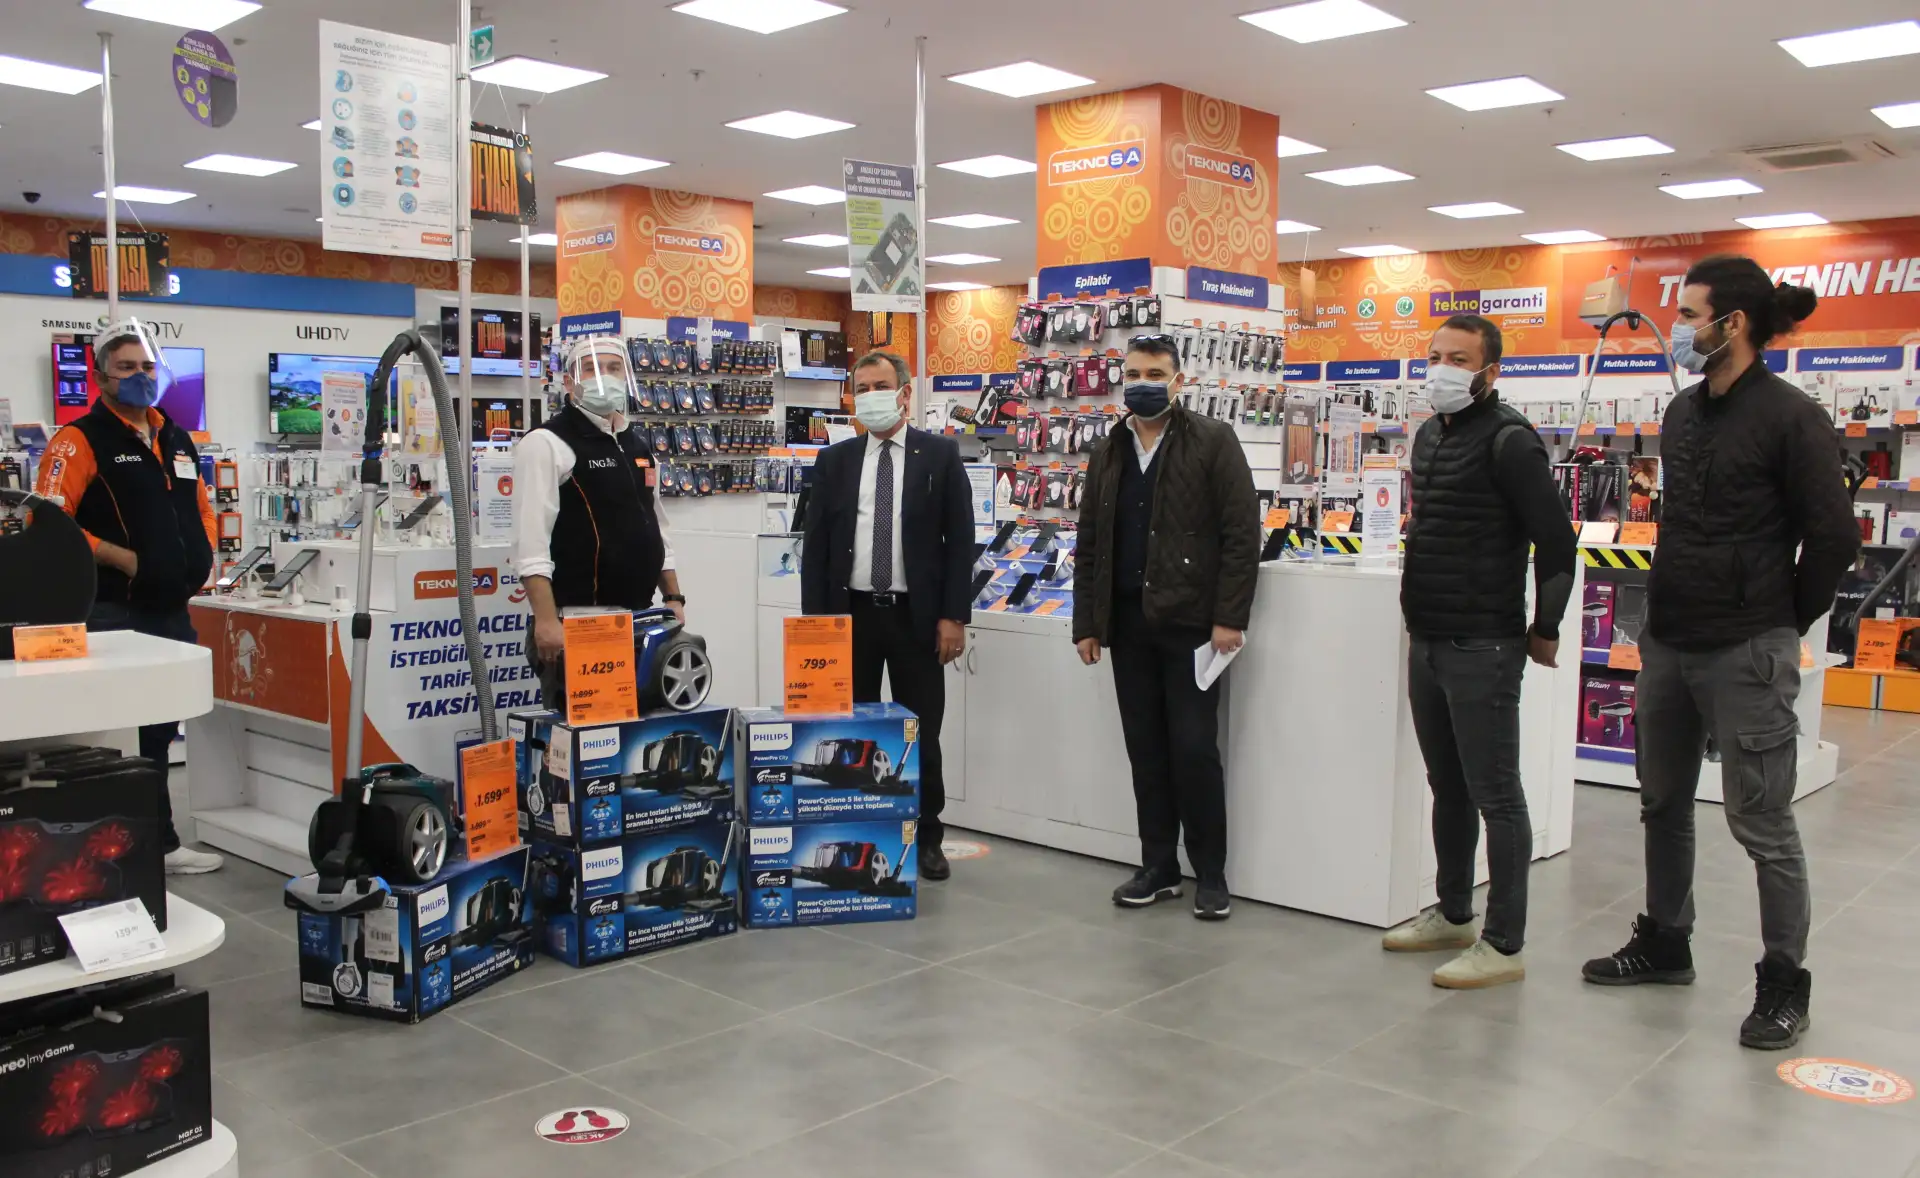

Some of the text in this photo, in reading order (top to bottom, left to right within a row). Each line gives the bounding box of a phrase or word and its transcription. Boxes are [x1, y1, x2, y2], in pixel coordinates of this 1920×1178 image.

[1052, 150, 1141, 175] TEKNOSA
[1186, 153, 1253, 182] TEKNOSA
[565, 232, 613, 249] TEKNOSA
[656, 233, 723, 251] TEKNOSA
[1075, 274, 1112, 288] Epilatör
[1202, 280, 1254, 298] Tıraş Makineleri
[42, 319, 92, 330] SAMSUNG
[1503, 316, 1544, 326] TEKNOSA
[566, 321, 581, 333] Kablo
[712, 328, 733, 338] ablolar
[1603, 358, 1657, 368] Mutfak Robotu
[1812, 354, 1887, 365] Kahve Makineleri
[1537, 362, 1575, 371] Makineleri
[114, 453, 142, 463] axess
[588, 459, 606, 469] ING
[417, 573, 493, 590] TEKNSA
[1586, 681, 1611, 690] arzum
[753, 733, 789, 742] PHILIPS
[583, 738, 617, 750] PHILIPS
[779, 772, 786, 781] 5
[608, 782, 615, 792] 8
[797, 797, 846, 806] PowerCyclone
[0, 806, 14, 816] me
[625, 813, 635, 821] En
[649, 807, 670, 817] tozları
[670, 805, 682, 813] bile
[797, 804, 822, 813] yüksek
[823, 803, 852, 813] düzeyde
[625, 818, 654, 829] oranında
[654, 814, 674, 824] toplar
[753, 836, 789, 846] PHILIPS
[585, 857, 620, 870] PHILIPS
[778, 857, 789, 865] City
[779, 875, 786, 884] 5
[420, 897, 446, 914] PHILIPS
[611, 900, 618, 910] 8
[797, 899, 845, 907] PowerCyclone
[797, 907, 821, 916] yüksek
[822, 905, 850, 914] düzeyde
[628, 930, 637, 938] En
[637, 928, 651, 936] ince
[652, 923, 672, 933] tozları
[672, 919, 684, 928] bile
[628, 934, 656, 945] oranında
[657, 929, 676, 941] toplar
[441, 943, 447, 955] 8
[453, 974, 460, 982] En
[460, 970, 470, 979] ince
[453, 976, 475, 990] oranında
[475, 968, 489, 980] toplar
[178, 1126, 203, 1141] MGF 01
